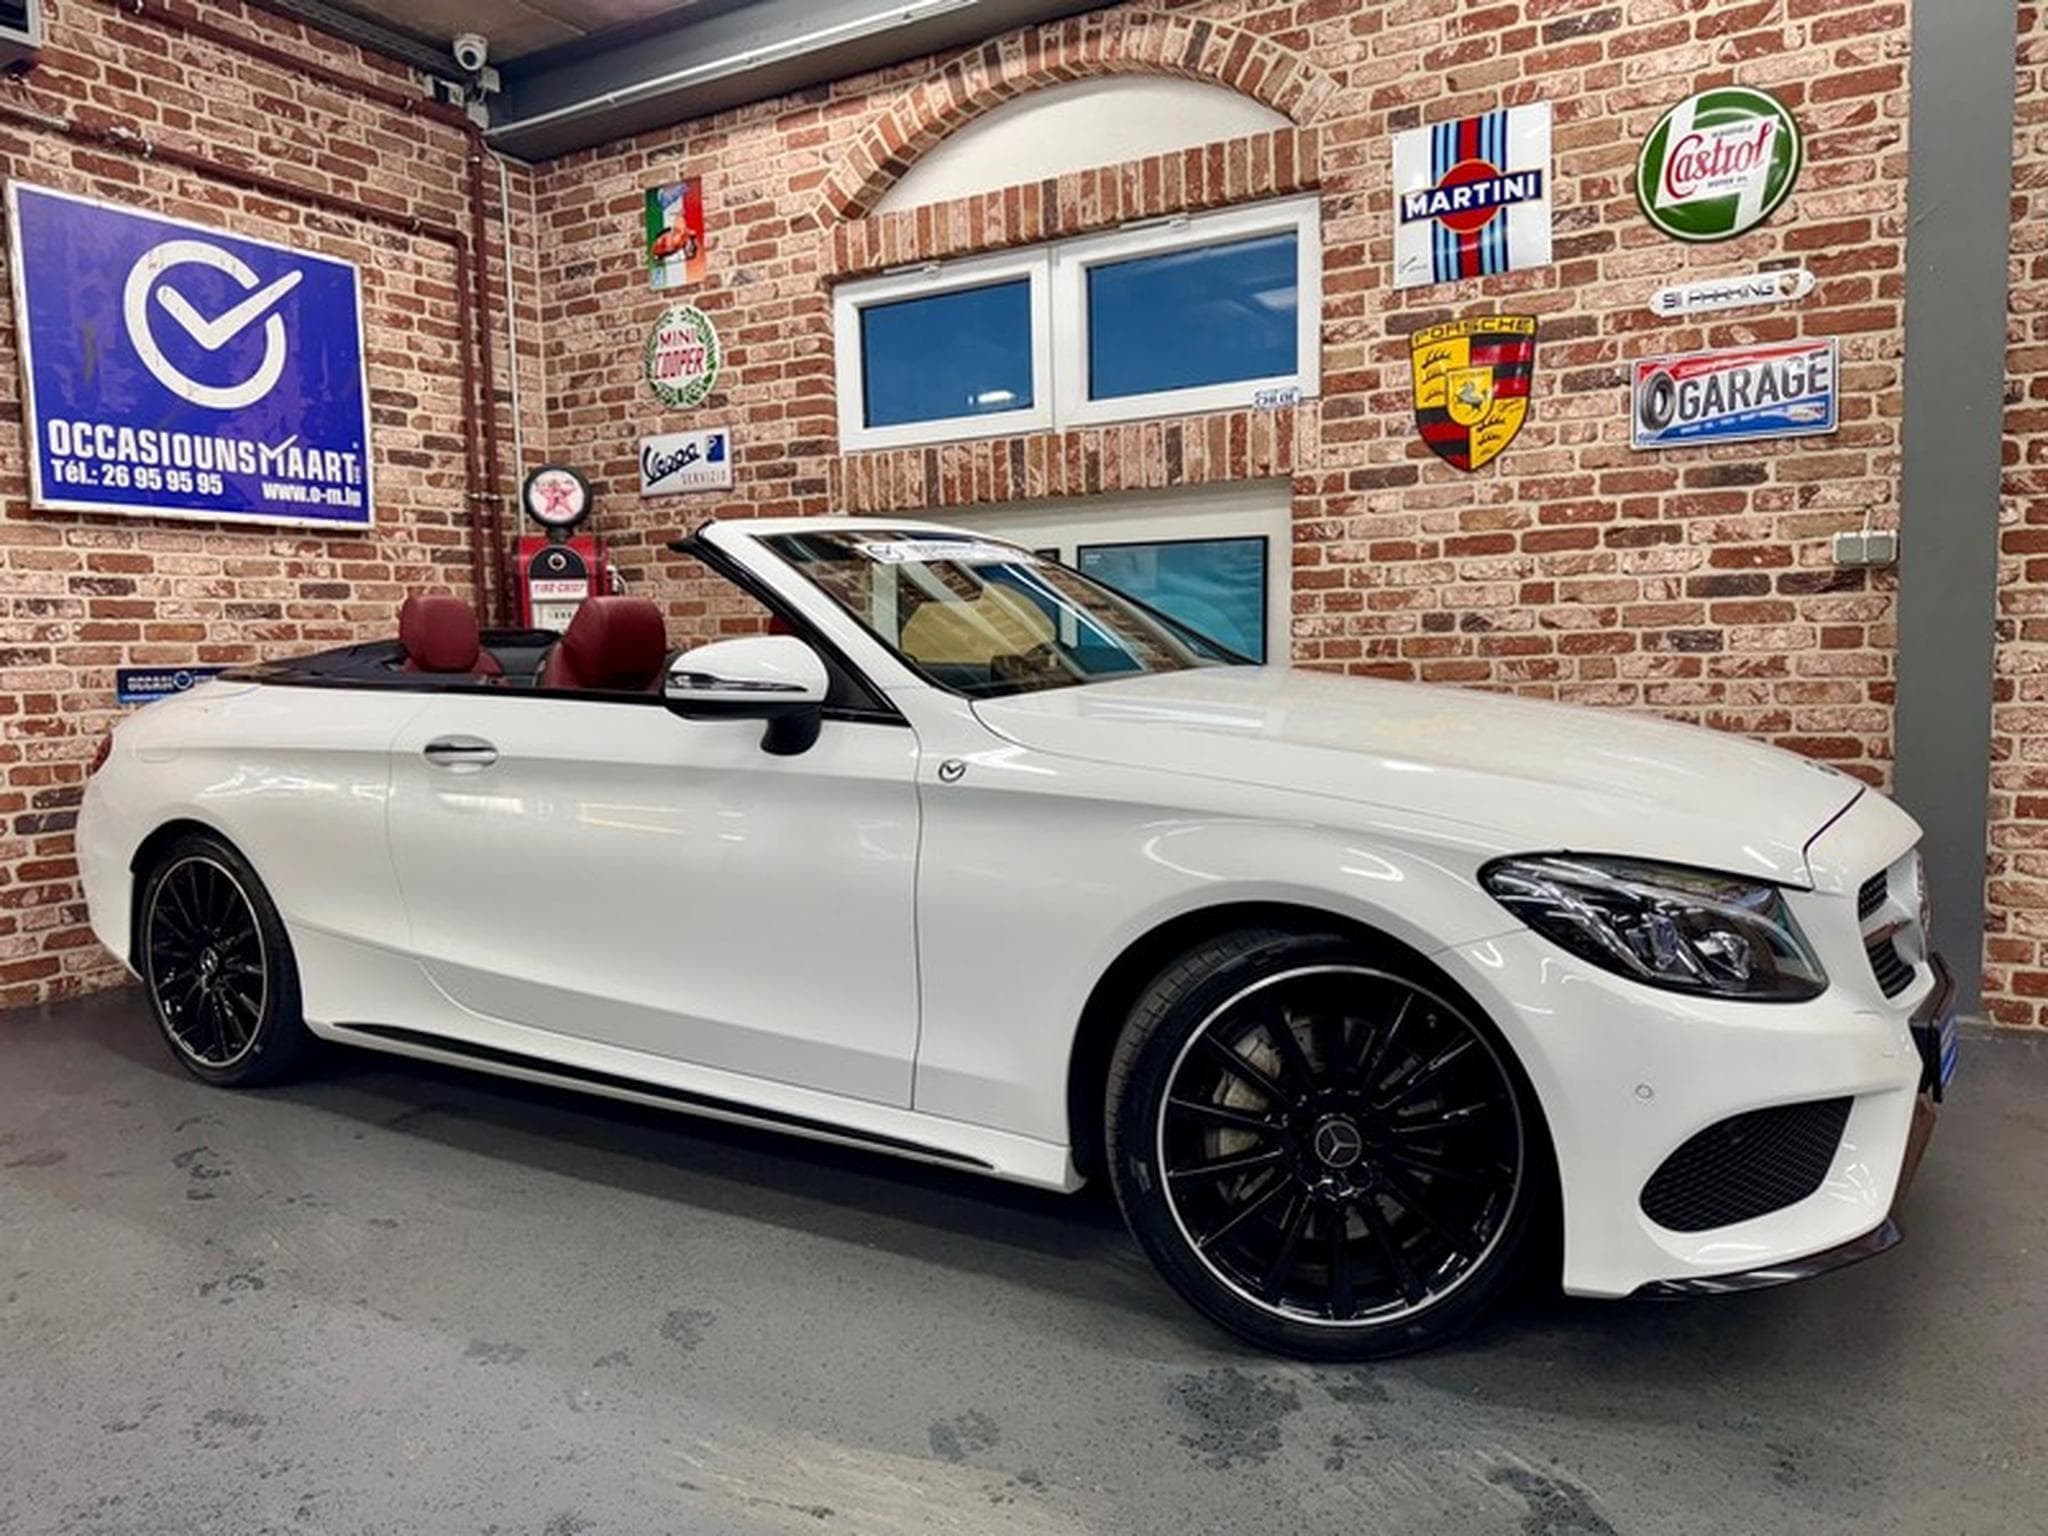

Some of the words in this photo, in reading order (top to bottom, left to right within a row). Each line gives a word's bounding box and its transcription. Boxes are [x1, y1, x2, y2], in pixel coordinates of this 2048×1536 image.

[1665, 121, 1773, 199] Castrol
[1406, 173, 1535, 219] MARTINI
[660, 328, 696, 349] MINI
[1415, 319, 1531, 343] PORSCHE
[656, 347, 705, 380] COOPER
[1678, 350, 1830, 421] GARAGE
[102, 463, 131, 488] 26
[134, 466, 162, 491] 95
[166, 469, 193, 494] 95
[196, 472, 224, 496] 95
[643, 443, 701, 487] Vespa
